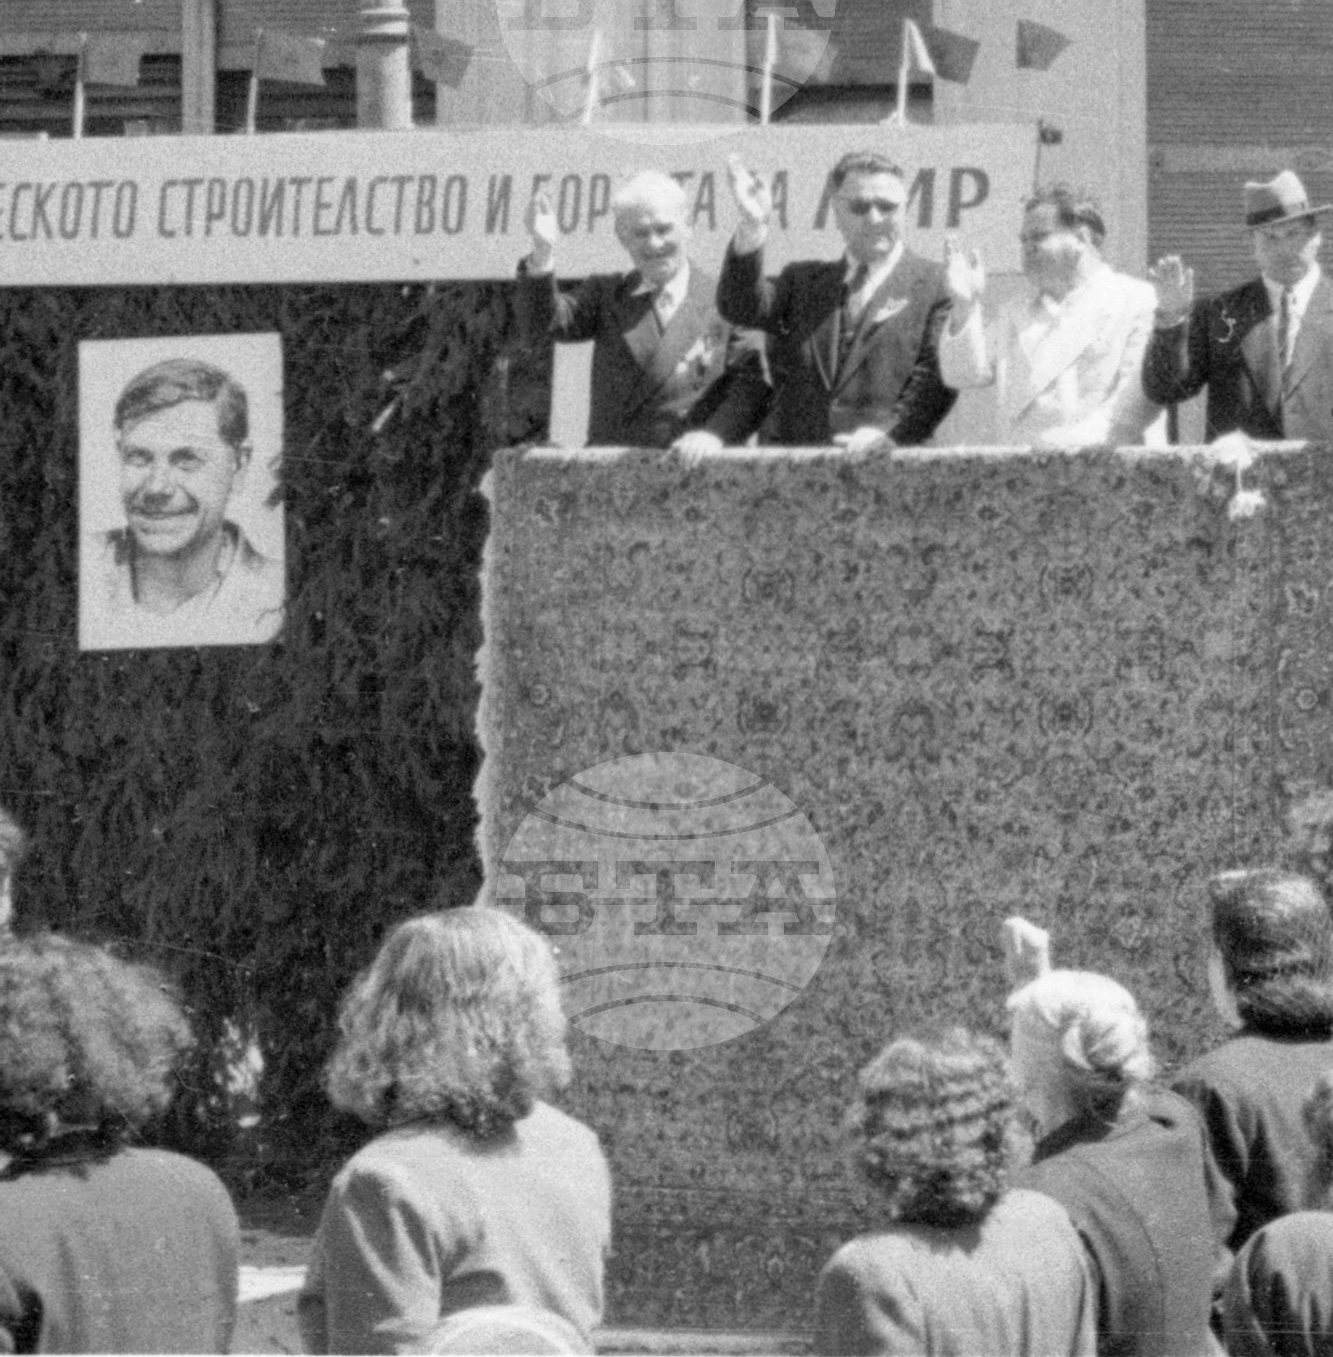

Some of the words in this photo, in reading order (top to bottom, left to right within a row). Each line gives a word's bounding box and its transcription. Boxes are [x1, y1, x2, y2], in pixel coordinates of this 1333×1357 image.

[0, 180, 138, 240] СКОТО
[157, 174, 468, 238] СТРОИТЕЛСТВО
[485, 173, 513, 234] И
